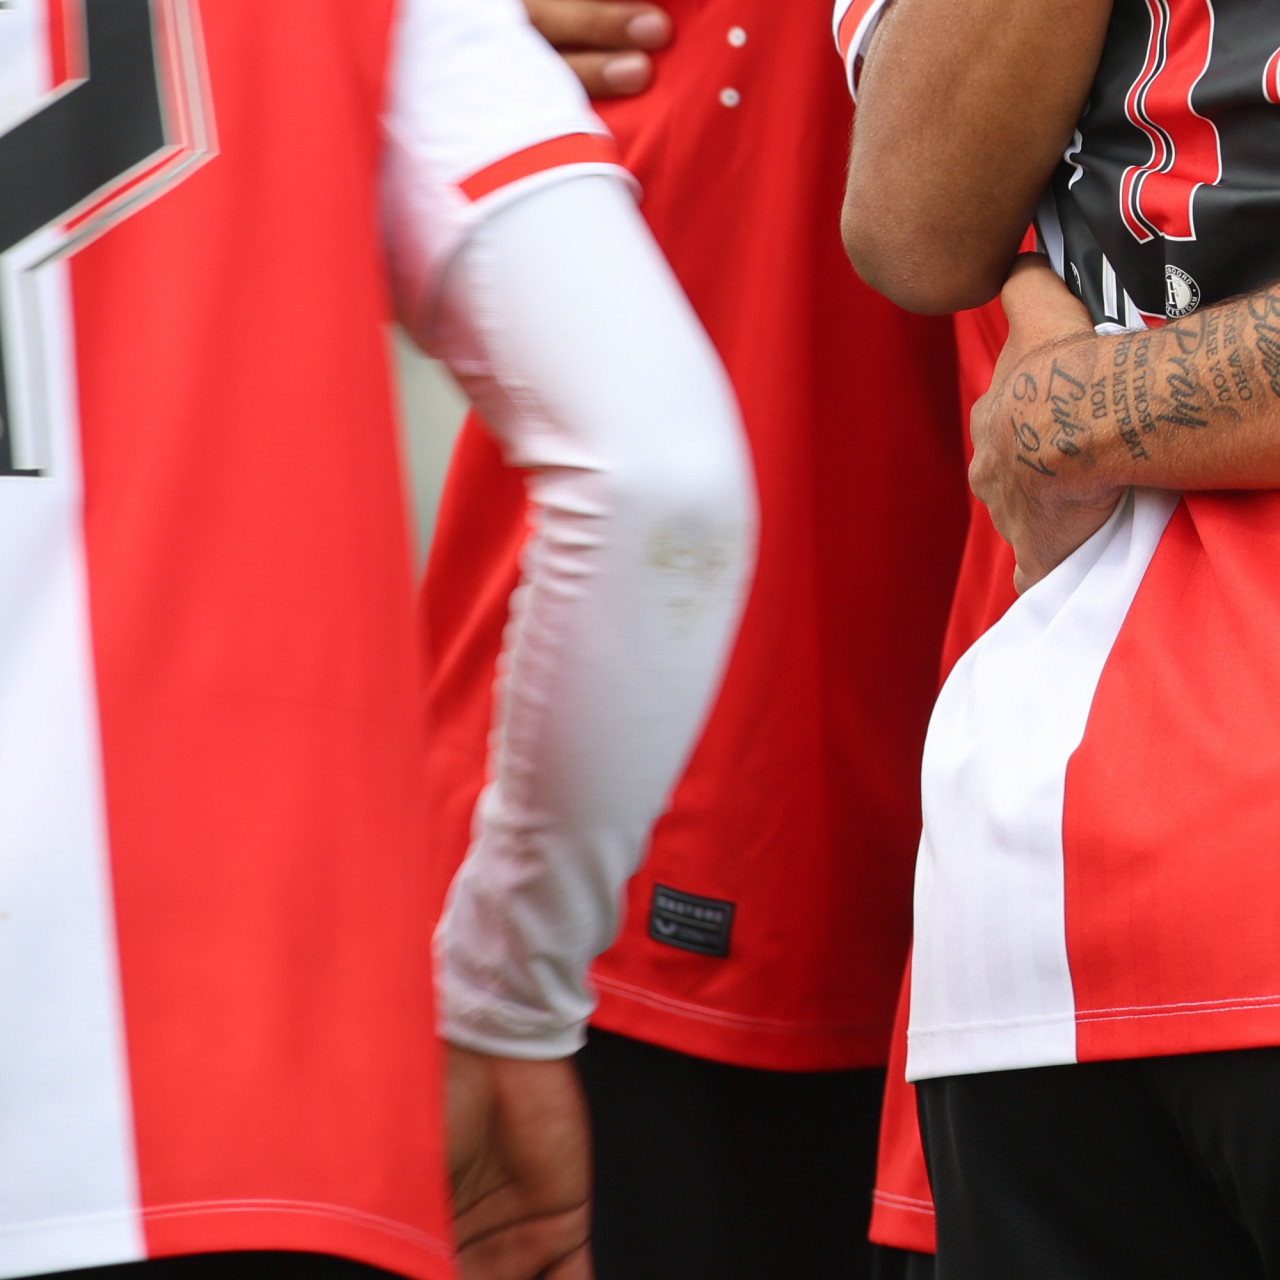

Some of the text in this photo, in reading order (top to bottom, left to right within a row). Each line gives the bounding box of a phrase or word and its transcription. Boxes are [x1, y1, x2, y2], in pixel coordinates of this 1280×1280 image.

[1045, 357, 1086, 458] Luke
[1090, 376, 1108, 420] YOU
[1132, 335, 1157, 434] FOR THOSE
[1157, 310, 1209, 429] Pray
[1208, 359, 1235, 402] YOU
[1228, 349, 1253, 401] WHO
[1112, 371, 1149, 460] MISTREAT
